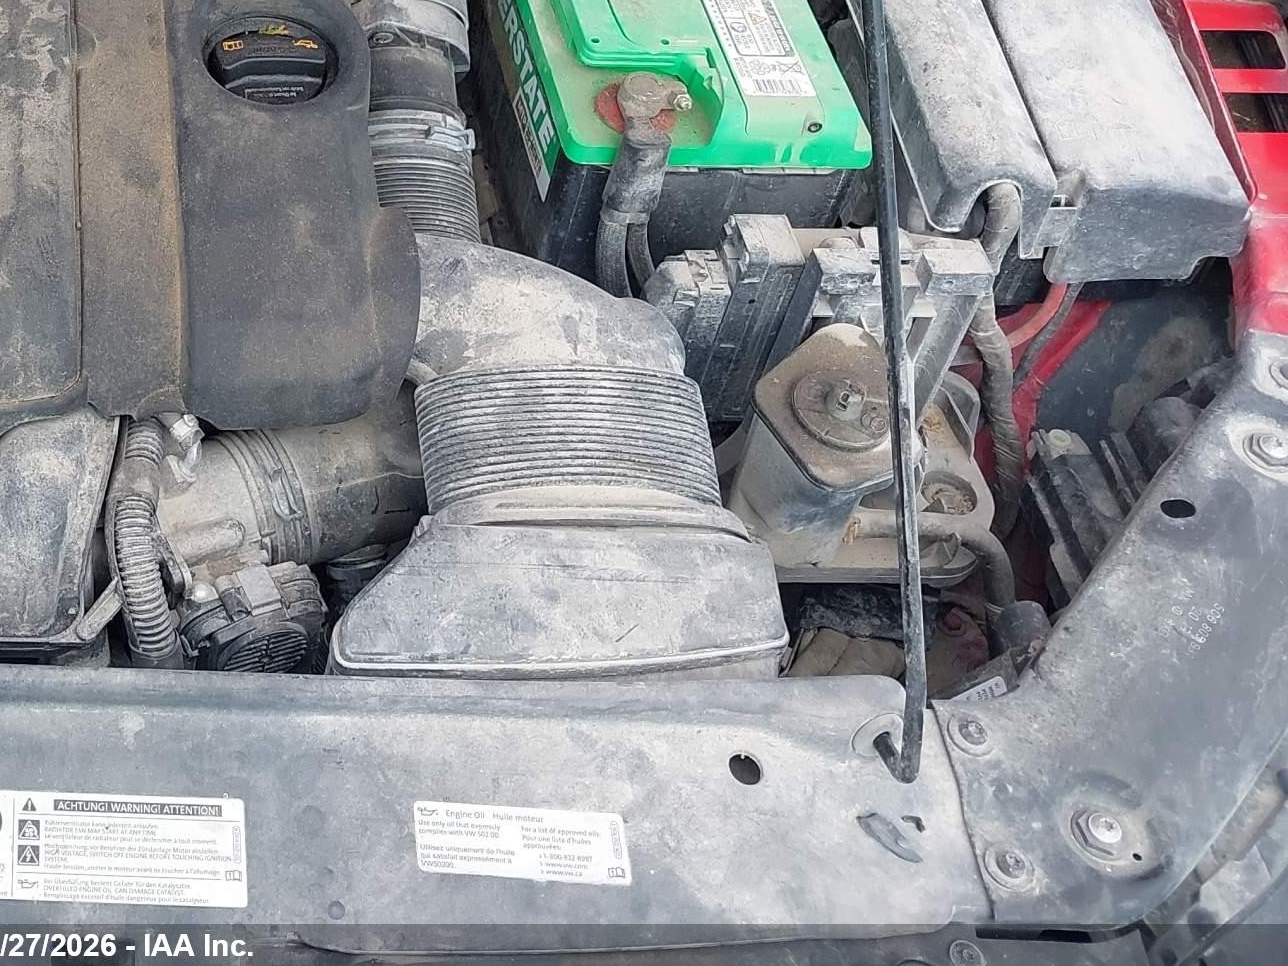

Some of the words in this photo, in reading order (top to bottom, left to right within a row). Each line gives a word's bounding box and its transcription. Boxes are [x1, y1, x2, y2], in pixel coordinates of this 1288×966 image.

[57, 800, 107, 811] ACHTUNG!
[110, 802, 160, 813] WARNING!
[163, 804, 218, 815] ATTENTION!
[445, 809, 472, 819] Engine
[492, 812, 512, 820] Huile
